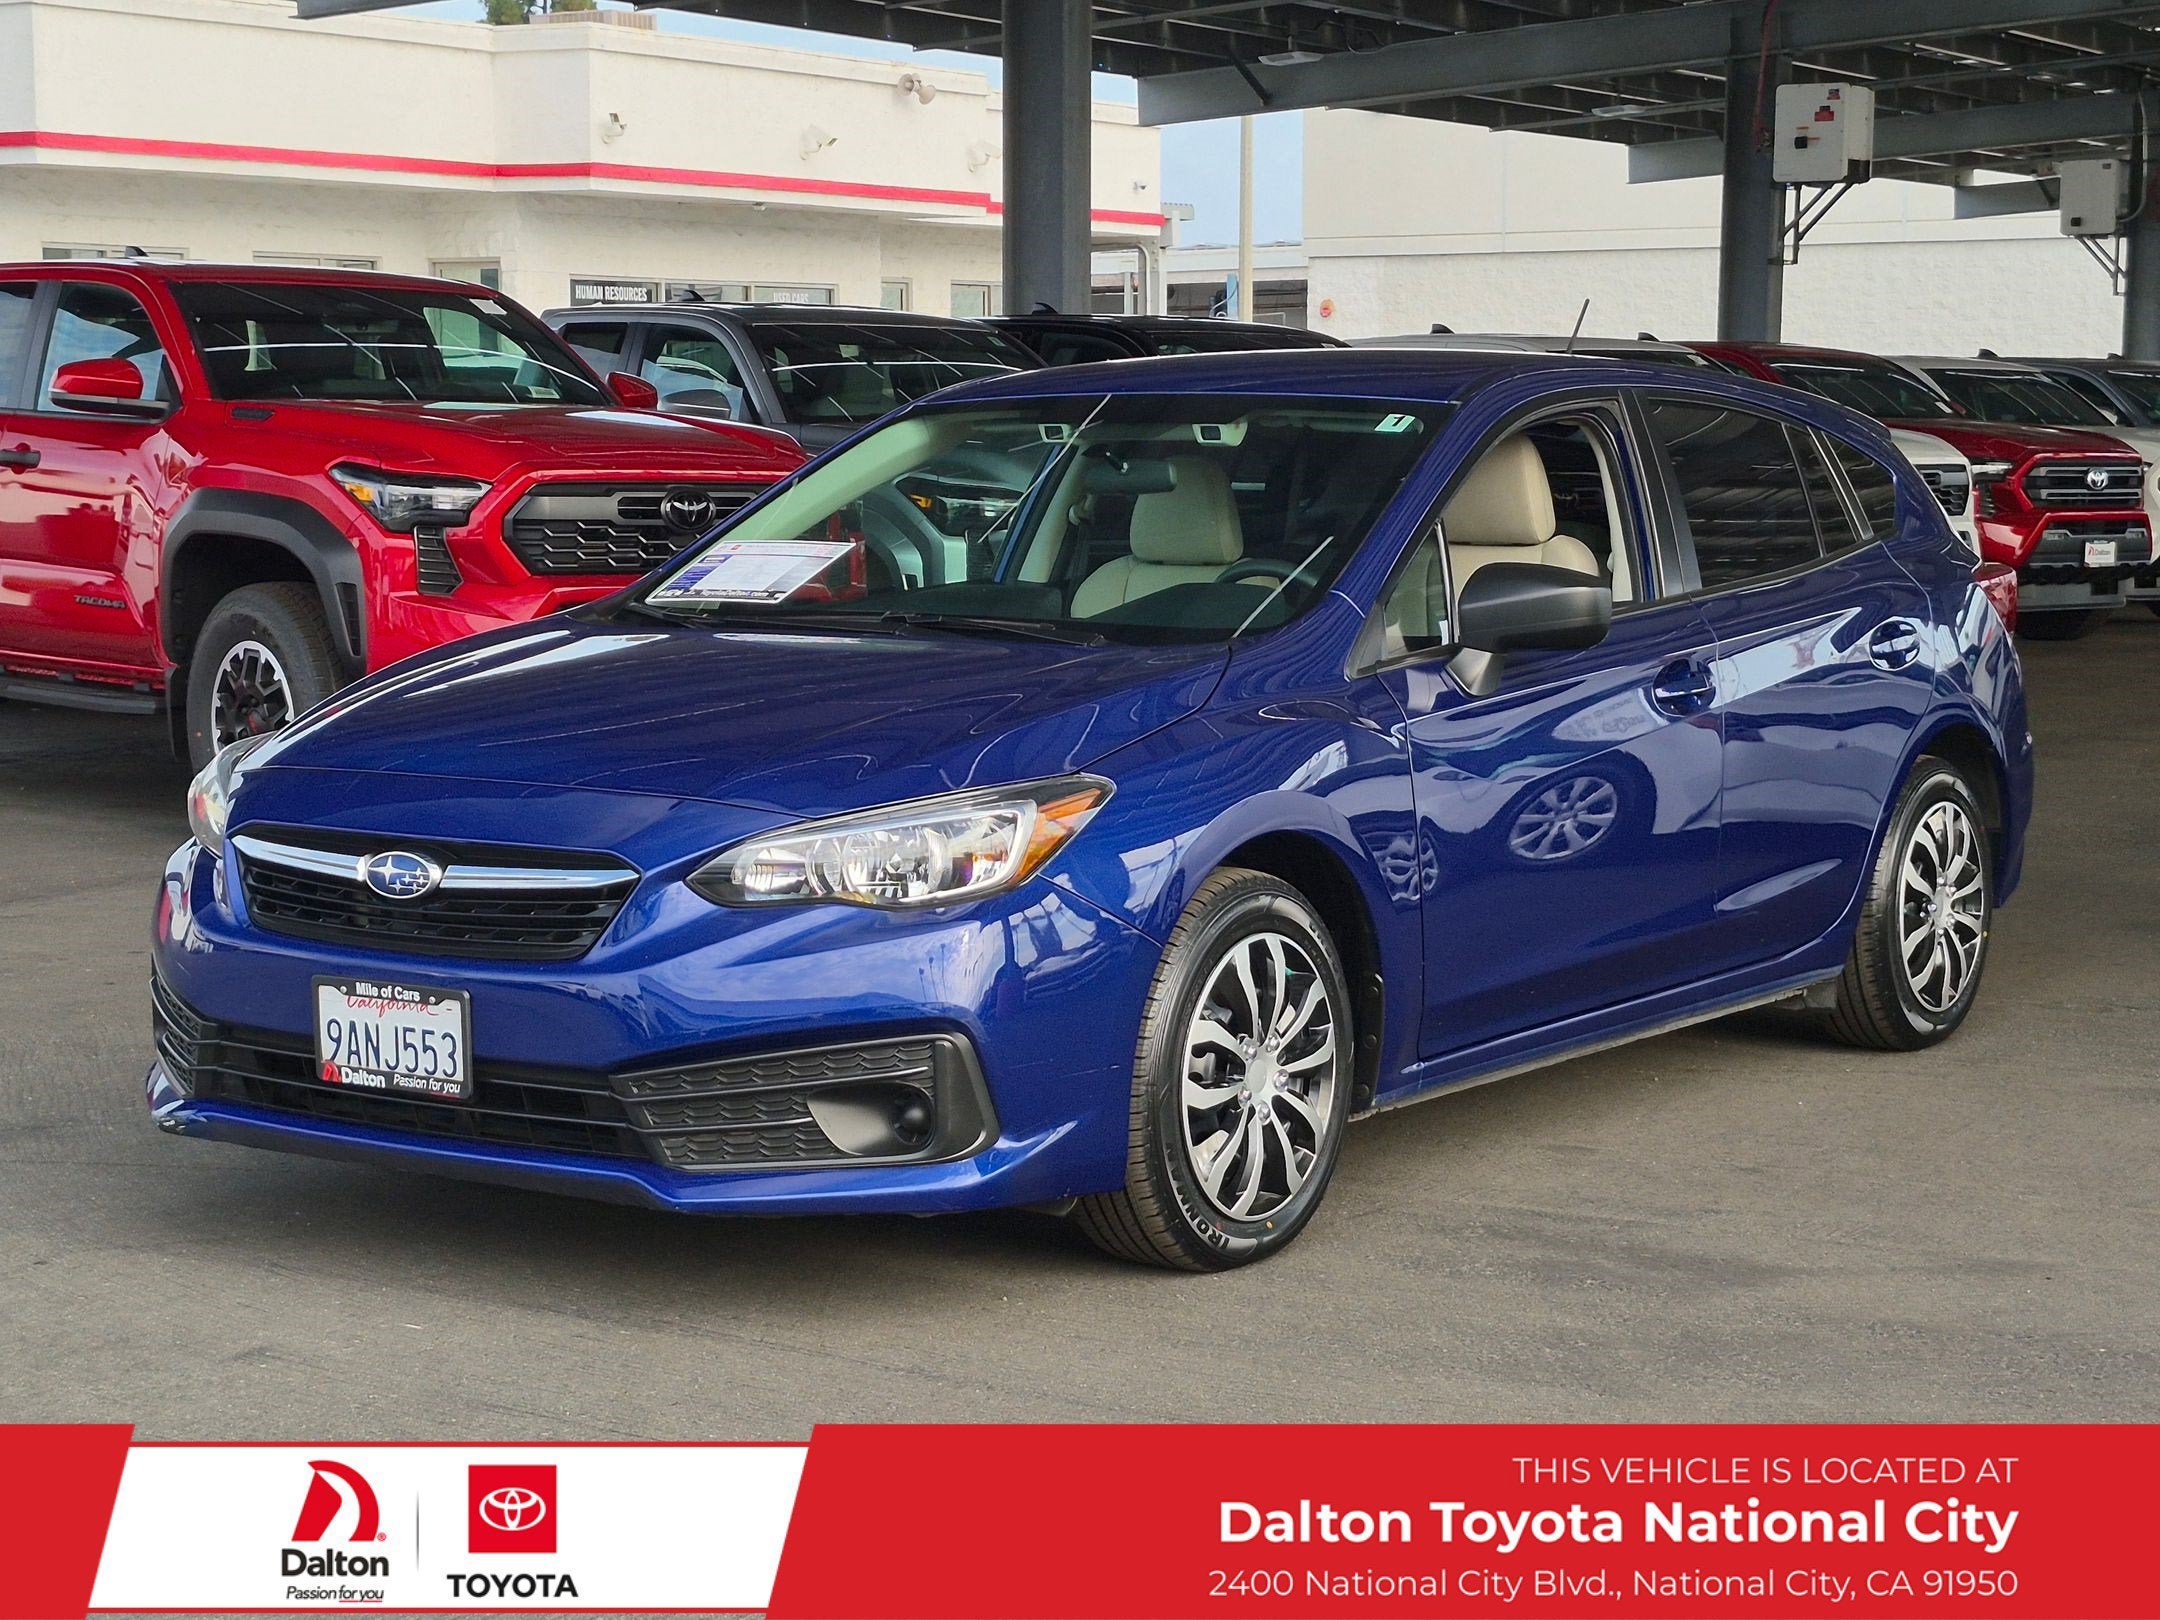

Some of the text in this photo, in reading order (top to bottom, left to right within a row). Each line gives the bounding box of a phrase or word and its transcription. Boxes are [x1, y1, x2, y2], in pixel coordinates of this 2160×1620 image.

[575, 284, 648, 302] HUMAN RESOURCES
[773, 292, 809, 304] USED CARS
[1392, 415, 1406, 427] 1
[74, 595, 125, 608] TACOMA
[356, 982, 421, 1001] Mile of Cars
[346, 995, 439, 1018] California
[327, 1018, 457, 1078] 9ANJ553
[341, 1067, 461, 1095] Dalton Passion for you
